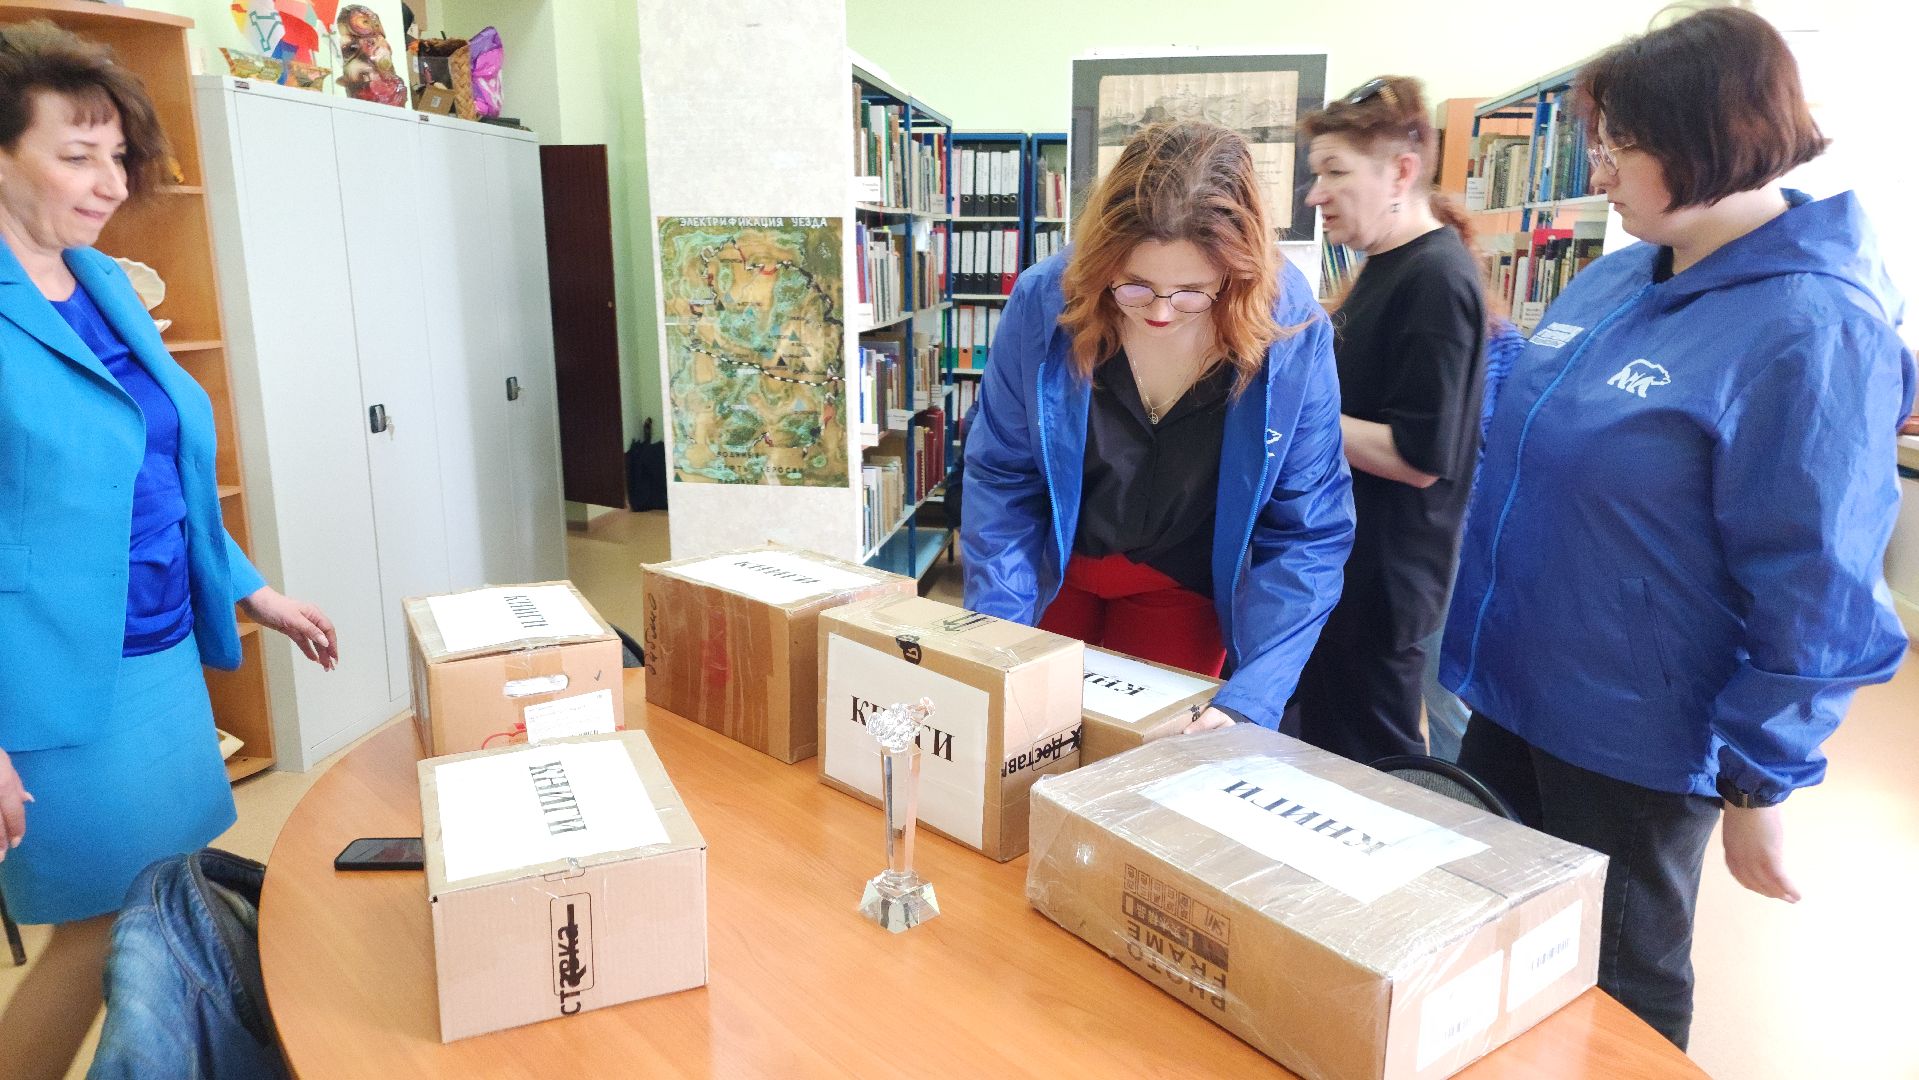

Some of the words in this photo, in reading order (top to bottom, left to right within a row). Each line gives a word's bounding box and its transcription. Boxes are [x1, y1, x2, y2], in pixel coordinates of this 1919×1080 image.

[679, 217, 784, 228] ЭЛЕКТРИФИКАЦИЯ
[791, 217, 828, 229] УЕЗДА
[733, 560, 823, 585] КНИГИ
[503, 594, 549, 629] КНИГИ
[851, 694, 956, 763] КГИ
[529, 760, 587, 837] КНИГИ
[1219, 779, 1390, 856] КНИГИ
[1128, 919, 1227, 991] FRAME
